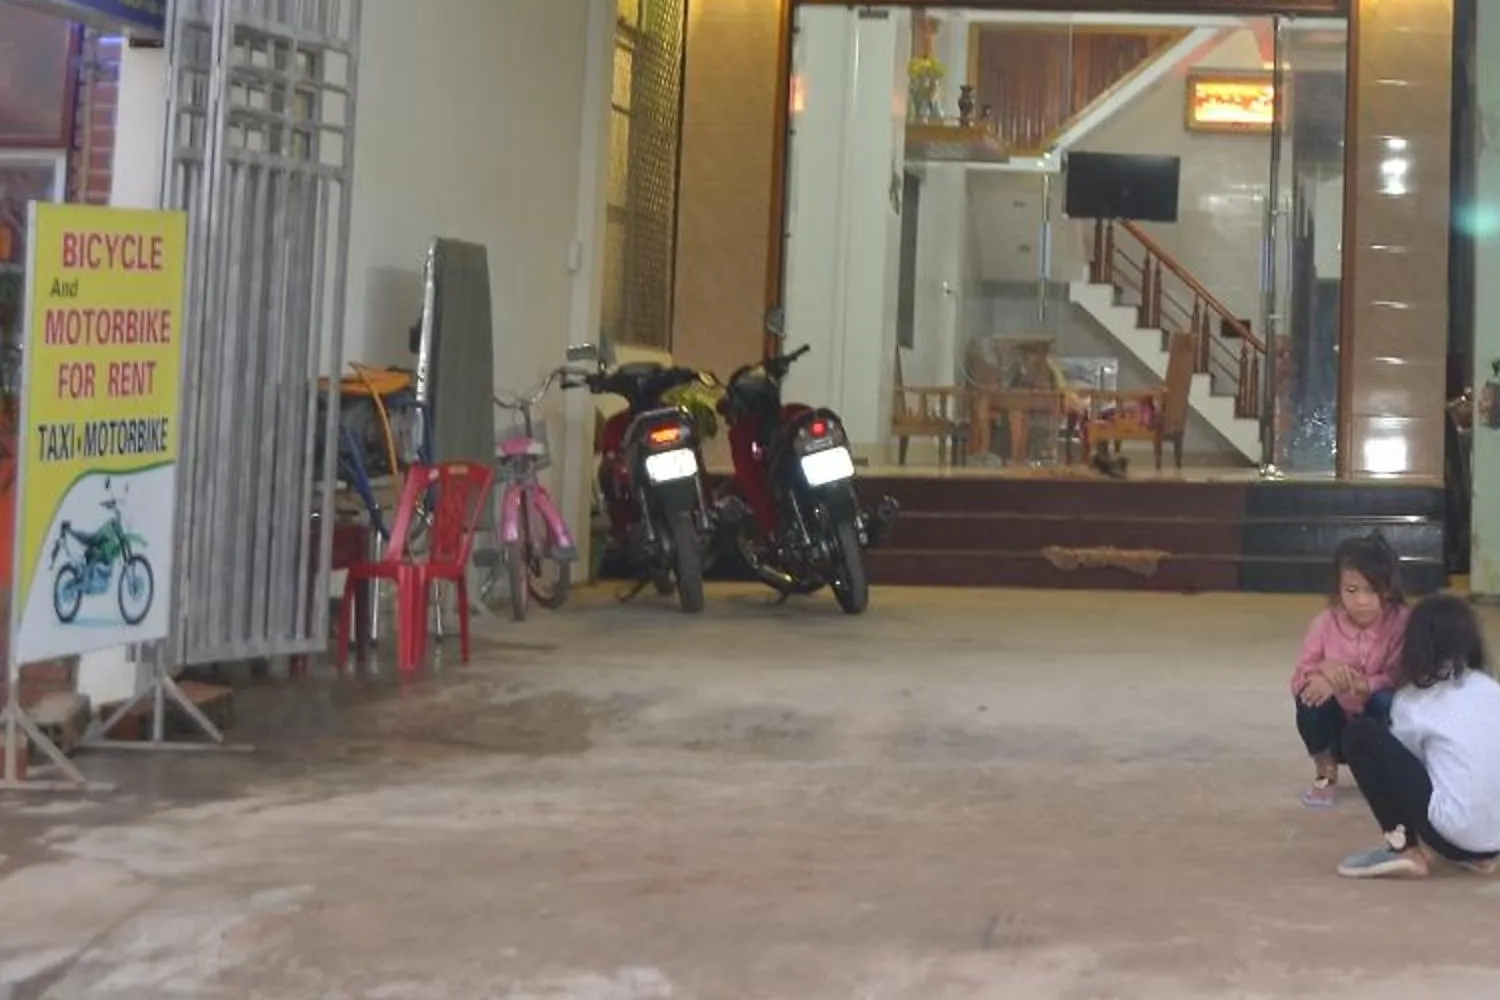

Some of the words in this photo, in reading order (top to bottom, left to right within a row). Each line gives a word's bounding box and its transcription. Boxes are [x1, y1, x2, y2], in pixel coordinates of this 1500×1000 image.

[62, 232, 163, 270] BICYCLE
[50, 277, 79, 298] And
[44, 309, 172, 345] MOTORBIKE
[57, 362, 96, 399] FOR
[107, 361, 157, 397] RENT
